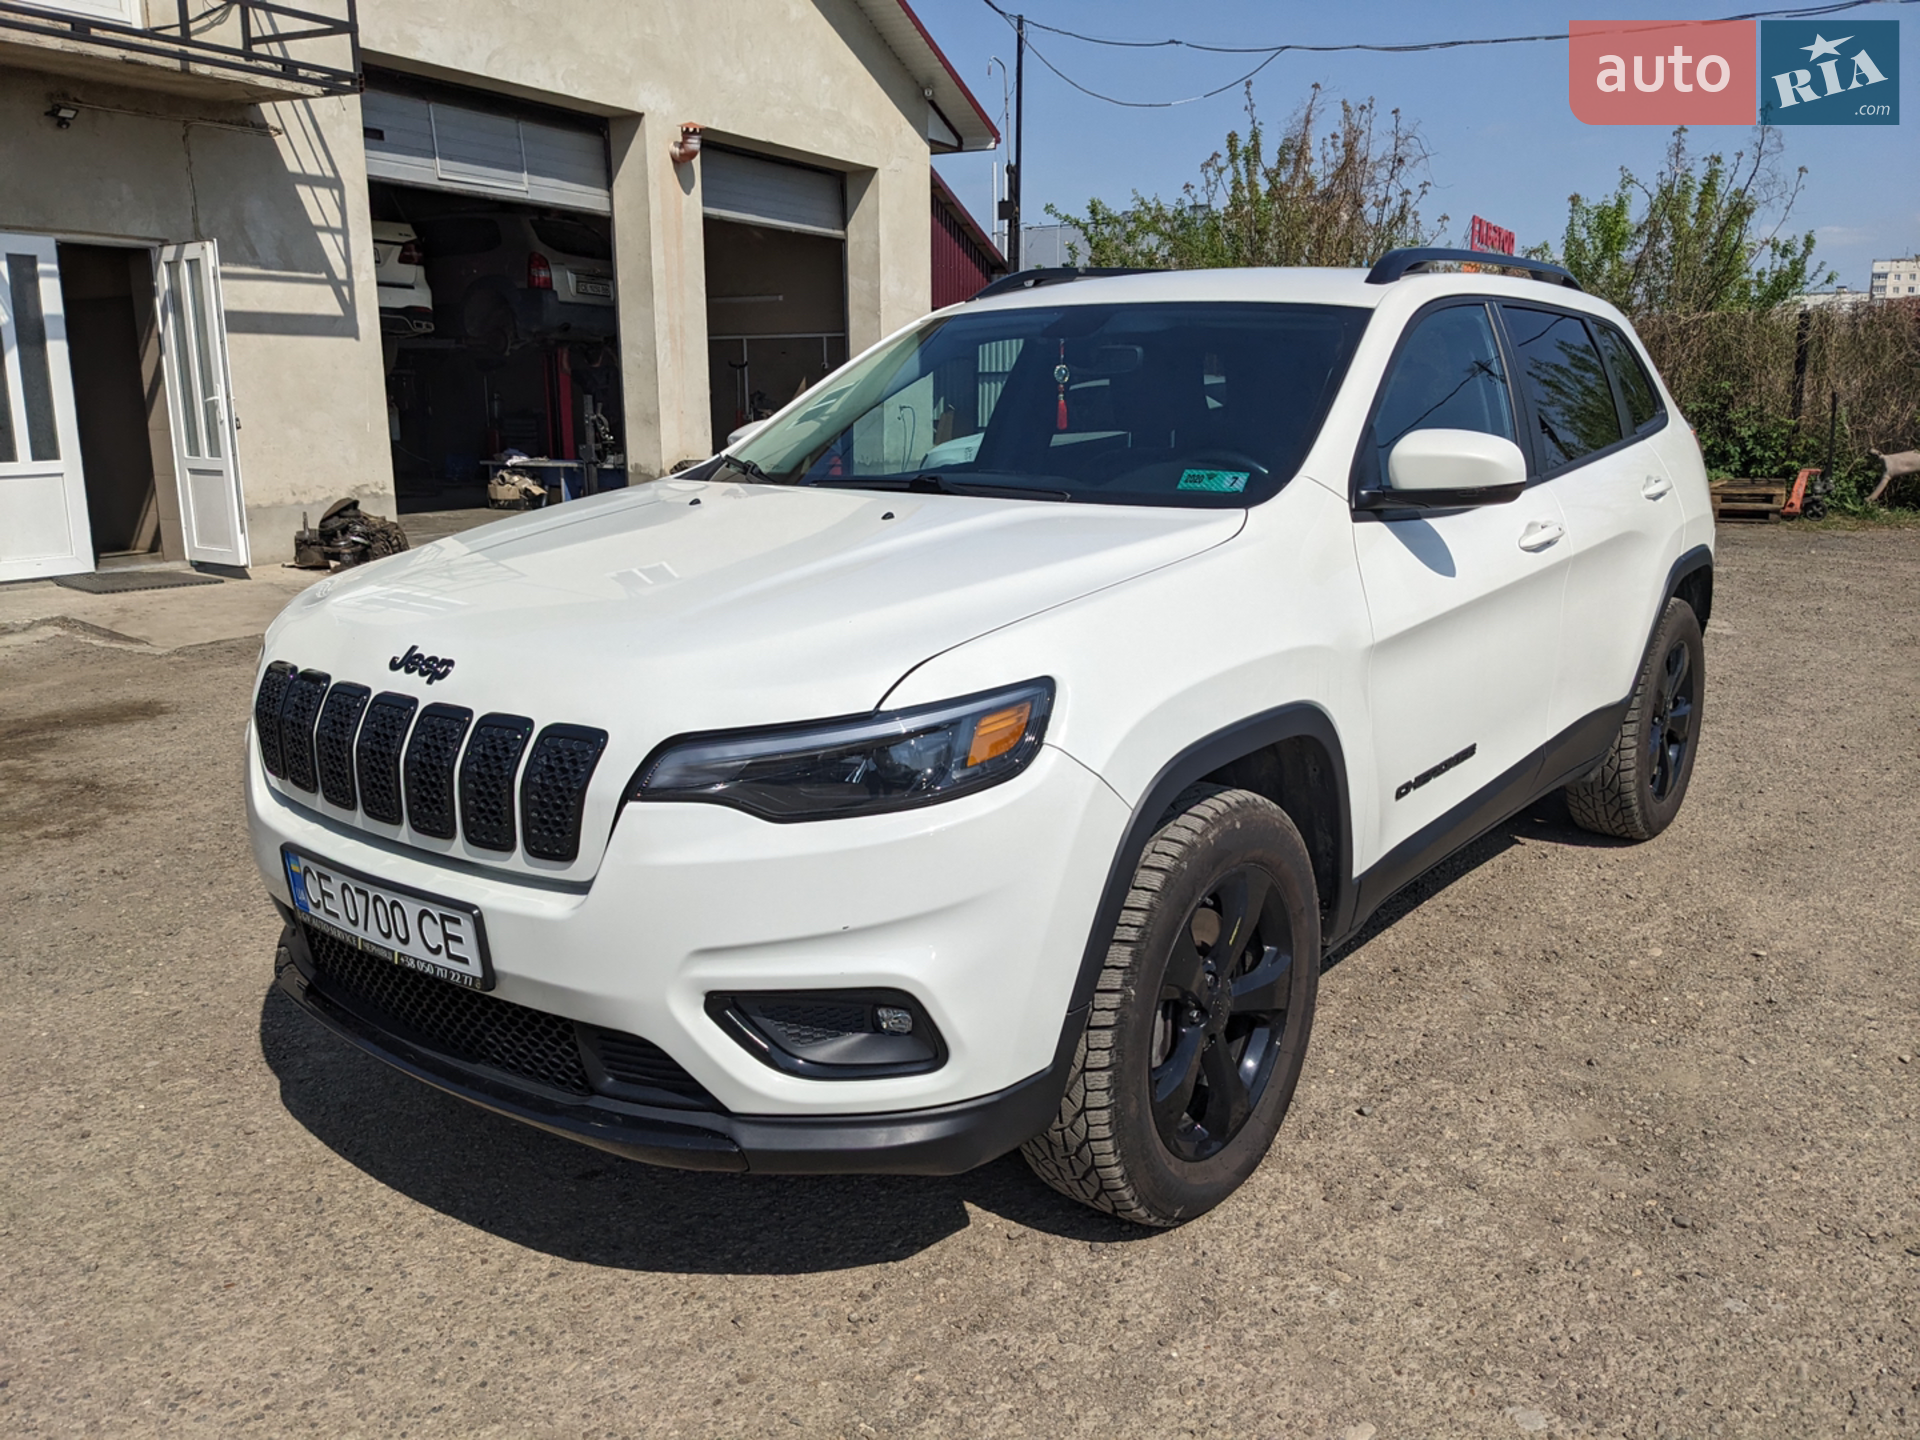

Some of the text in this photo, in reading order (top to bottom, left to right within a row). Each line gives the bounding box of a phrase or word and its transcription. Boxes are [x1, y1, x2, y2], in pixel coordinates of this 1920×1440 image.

[1229, 475, 1240, 488] 7
[388, 644, 456, 686] Jeep
[302, 865, 471, 966] CE 0700 CE
[416, 960, 434, 974] 050
